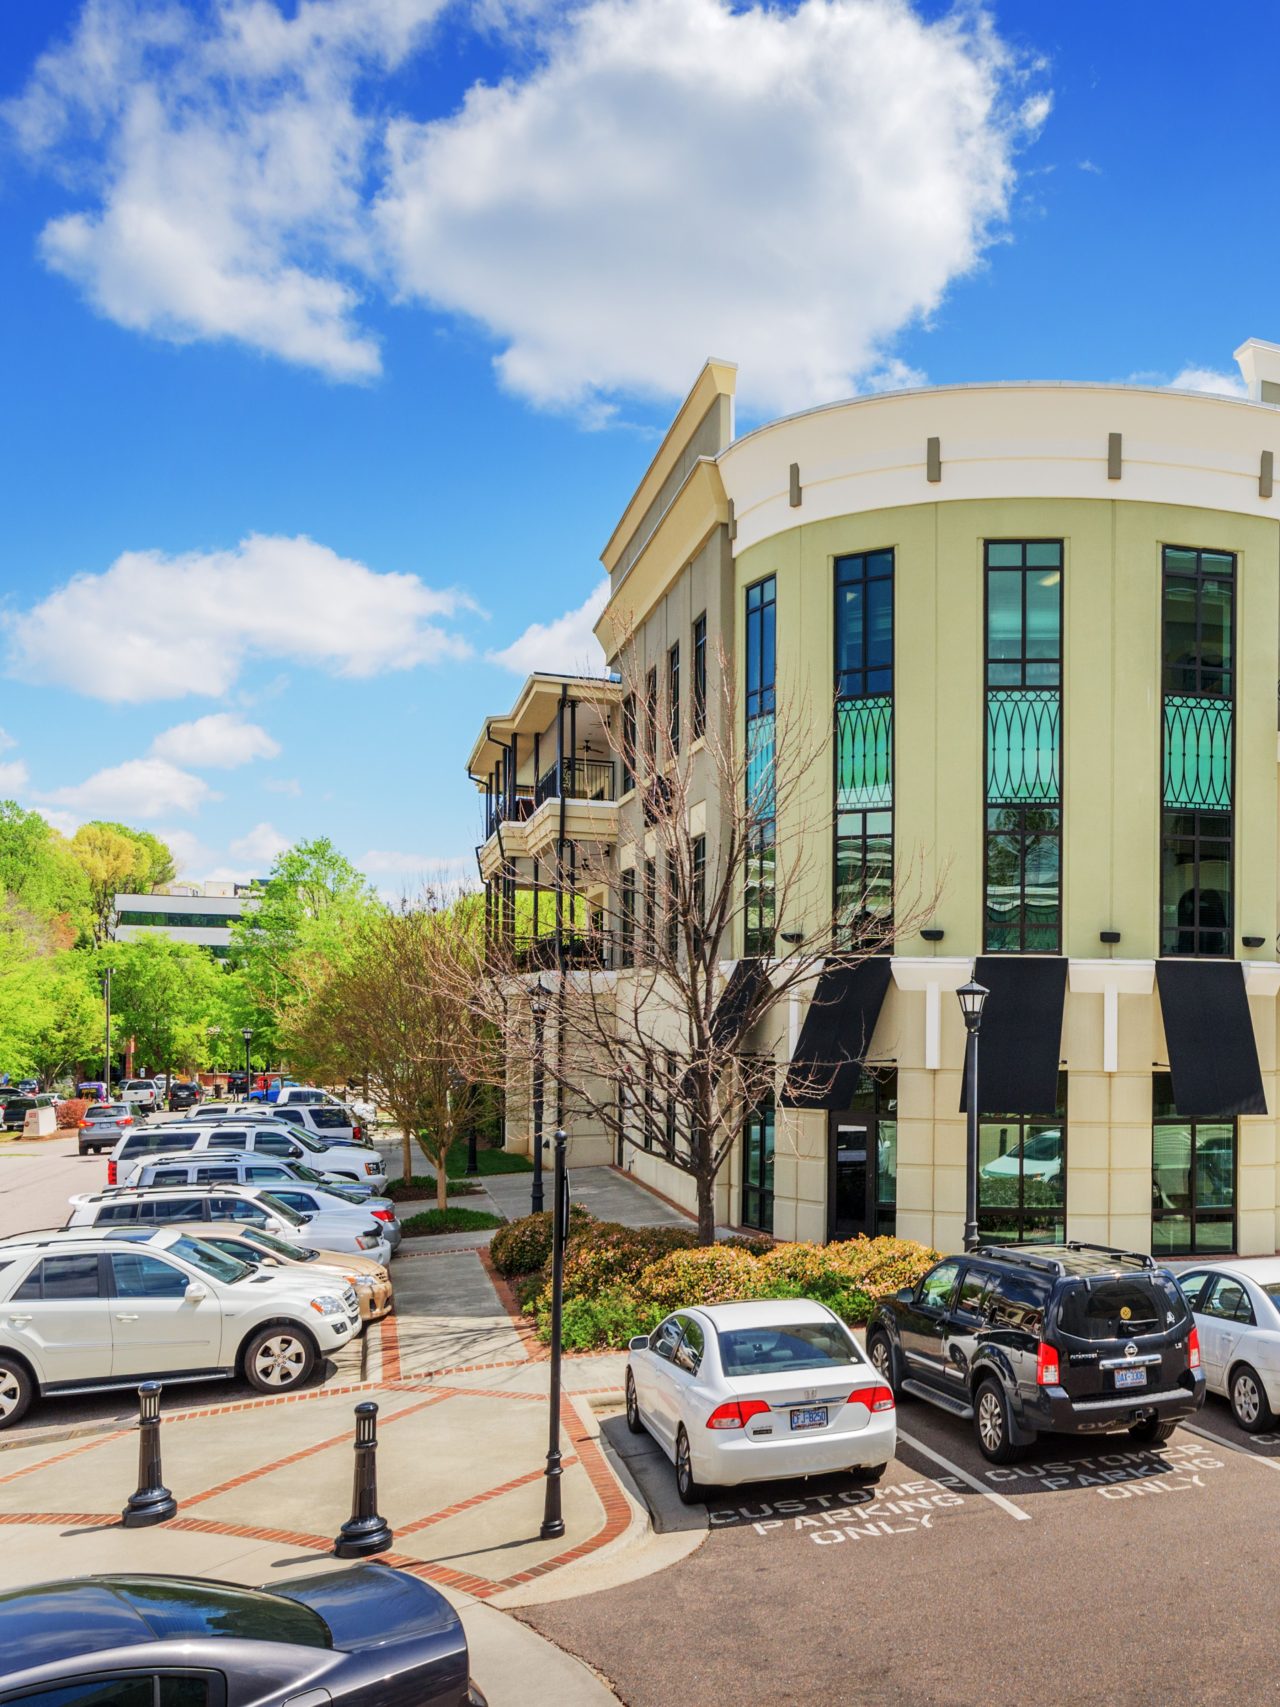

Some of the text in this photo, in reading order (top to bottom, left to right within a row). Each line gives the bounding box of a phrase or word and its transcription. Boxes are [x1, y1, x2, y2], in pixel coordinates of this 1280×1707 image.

[984, 1443, 1213, 1482] CUSTOMER
[1040, 1457, 1225, 1491] PARKING
[709, 1476, 968, 1525] CUSTOMER
[1096, 1474, 1206, 1500] ONLY
[750, 1493, 965, 1536] PARKING
[809, 1513, 933, 1546] ONLY
